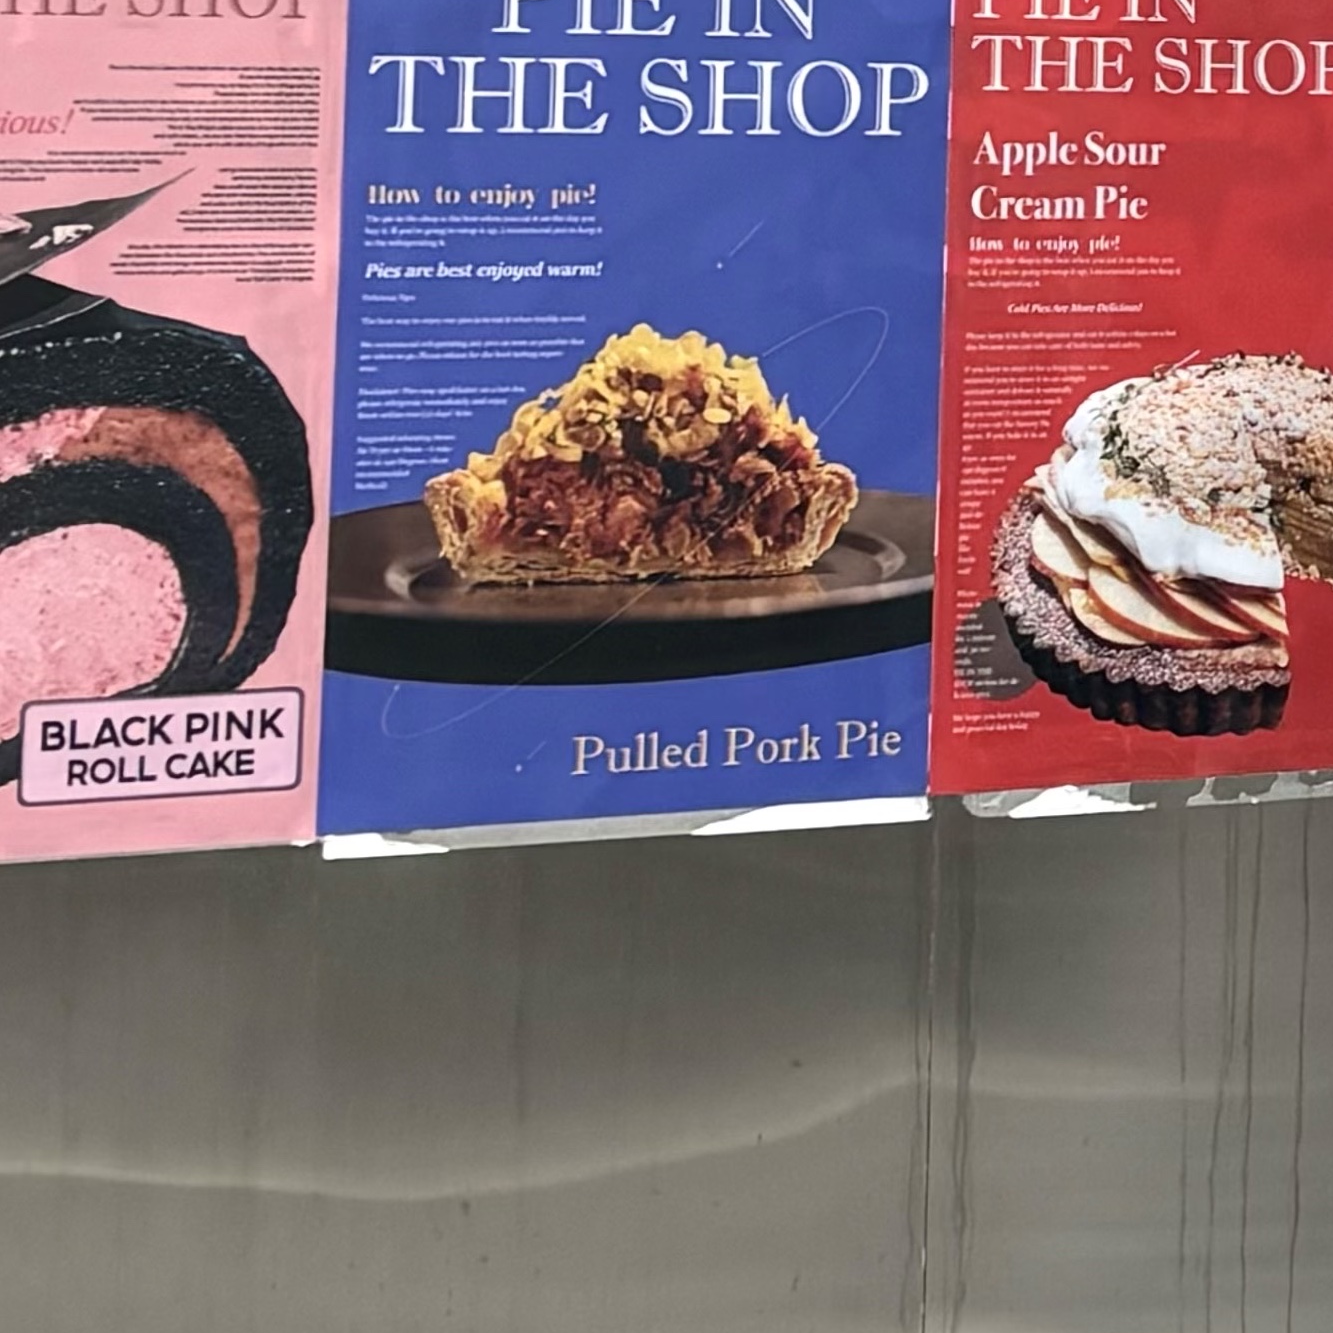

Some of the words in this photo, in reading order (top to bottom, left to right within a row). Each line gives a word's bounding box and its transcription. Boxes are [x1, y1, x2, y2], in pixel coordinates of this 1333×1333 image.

[970, 35, 1134, 93] THE
[367, 54, 609, 135] THE
[637, 58, 930, 138] SHOP
[0, 108, 75, 135] ious!
[973, 131, 1078, 176] Apple
[1083, 131, 1166, 166] Sour
[367, 184, 420, 205] How
[435, 186, 460, 204] to
[470, 184, 536, 209] enjoy
[552, 184, 596, 209] pie!
[970, 185, 1085, 220] Cream
[1094, 185, 1149, 220] Pie
[969, 236, 1003, 251] How
[1014, 237, 1030, 251] to
[1036, 236, 1080, 254] enjoy
[1089, 236, 1120, 254] pie!
[364, 262, 402, 278] Pies
[404, 268, 434, 278] are
[436, 262, 472, 278] best
[476, 262, 544, 282] enjoyed
[547, 262, 604, 277] warm!
[40, 713, 174, 752] BLACK
[184, 708, 285, 743] PINK
[570, 729, 709, 776] Pulled
[722, 723, 821, 767] Pork
[835, 720, 902, 759] Pie
[66, 755, 157, 786] ROLL
[164, 749, 255, 779] CAKE
